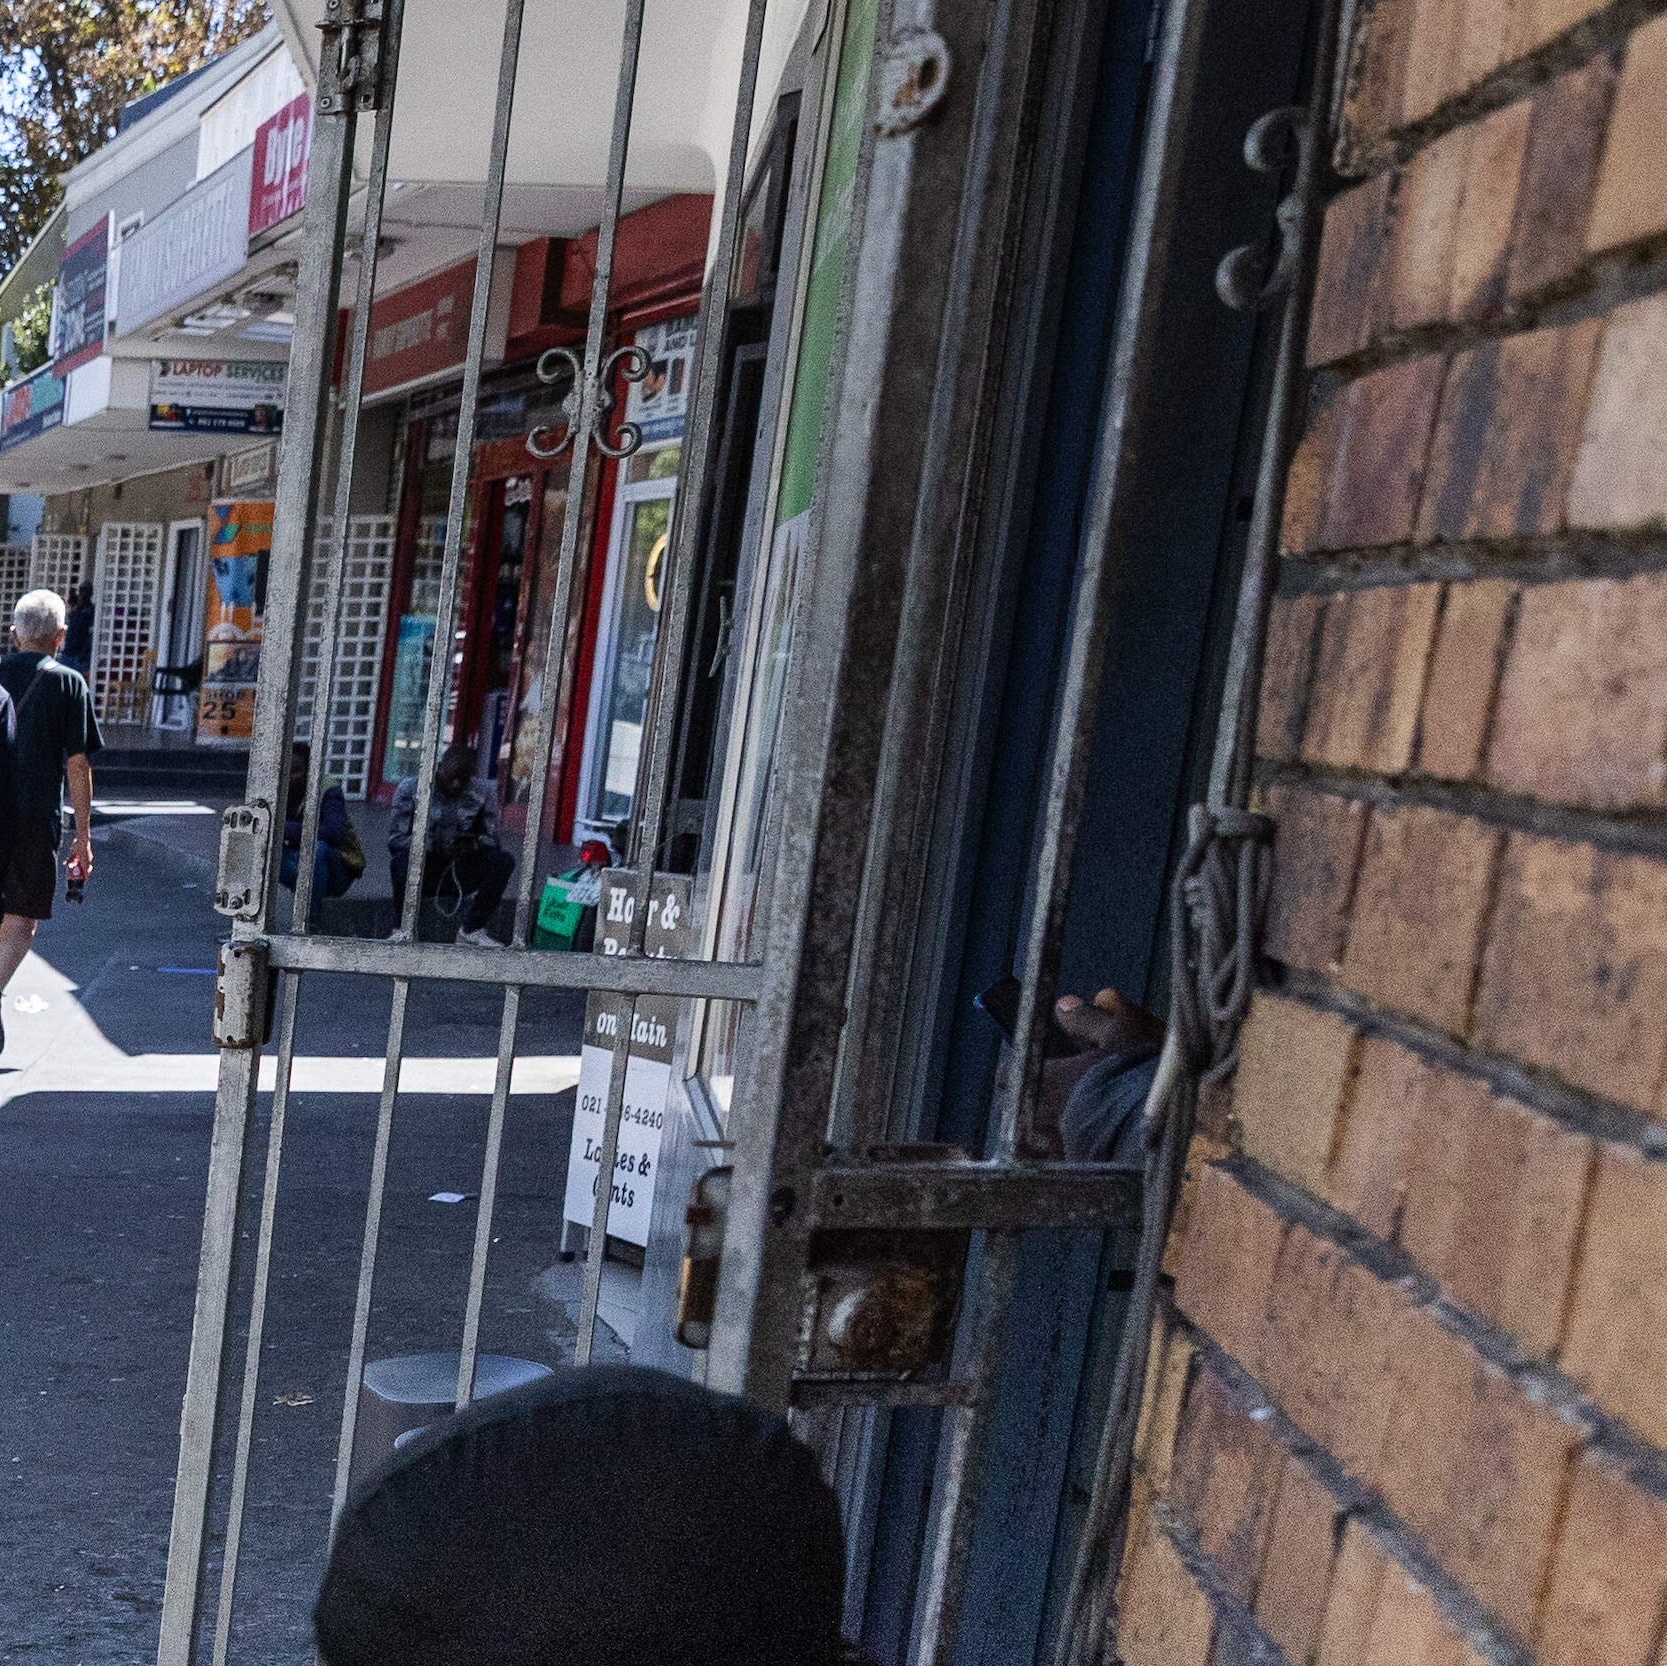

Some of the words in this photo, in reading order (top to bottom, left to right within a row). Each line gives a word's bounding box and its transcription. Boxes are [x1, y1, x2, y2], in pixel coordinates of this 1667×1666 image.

[263, 116, 305, 187] Byte
[172, 359, 222, 377] LAPTOP
[202, 701, 237, 720] 25
[660, 893, 681, 931] &
[638, 1152, 651, 1177] &
[593, 1174, 635, 1208] nts
